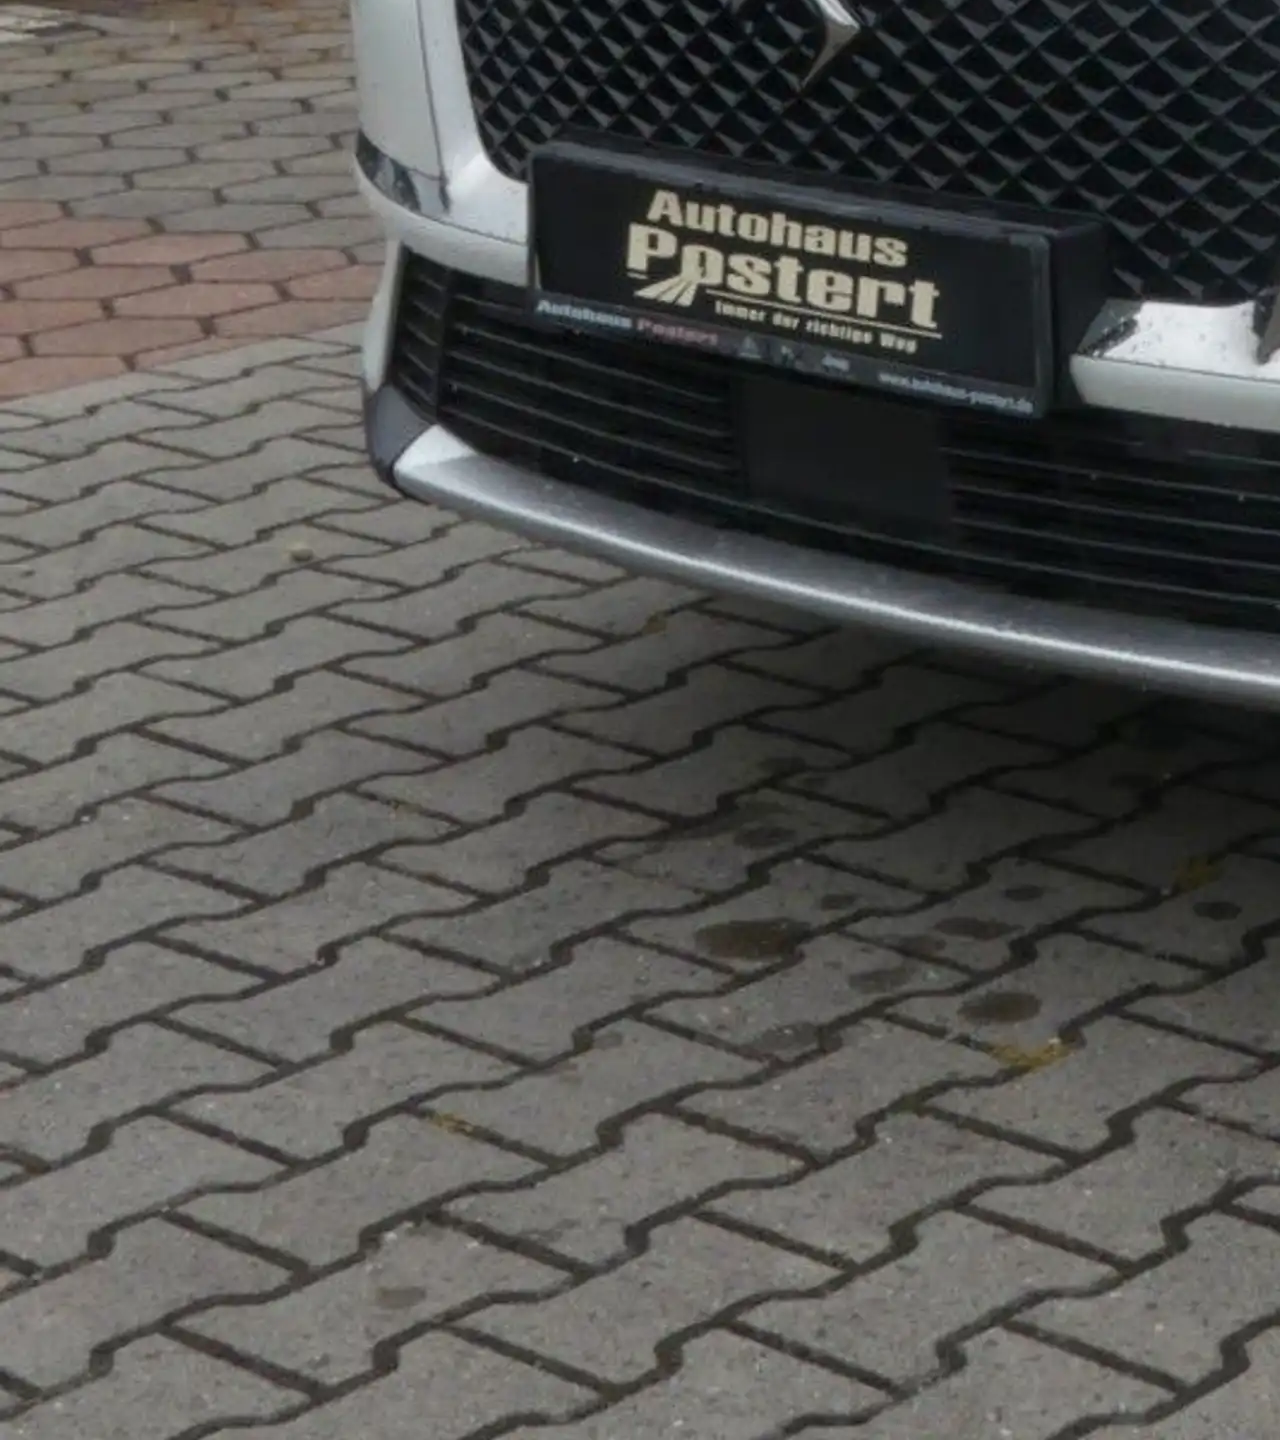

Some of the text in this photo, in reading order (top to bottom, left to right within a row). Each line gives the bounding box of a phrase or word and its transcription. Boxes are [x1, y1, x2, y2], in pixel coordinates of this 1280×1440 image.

[646, 189, 910, 268] Autohaus
[626, 222, 941, 331] Postert
[879, 331, 918, 355] Weg
